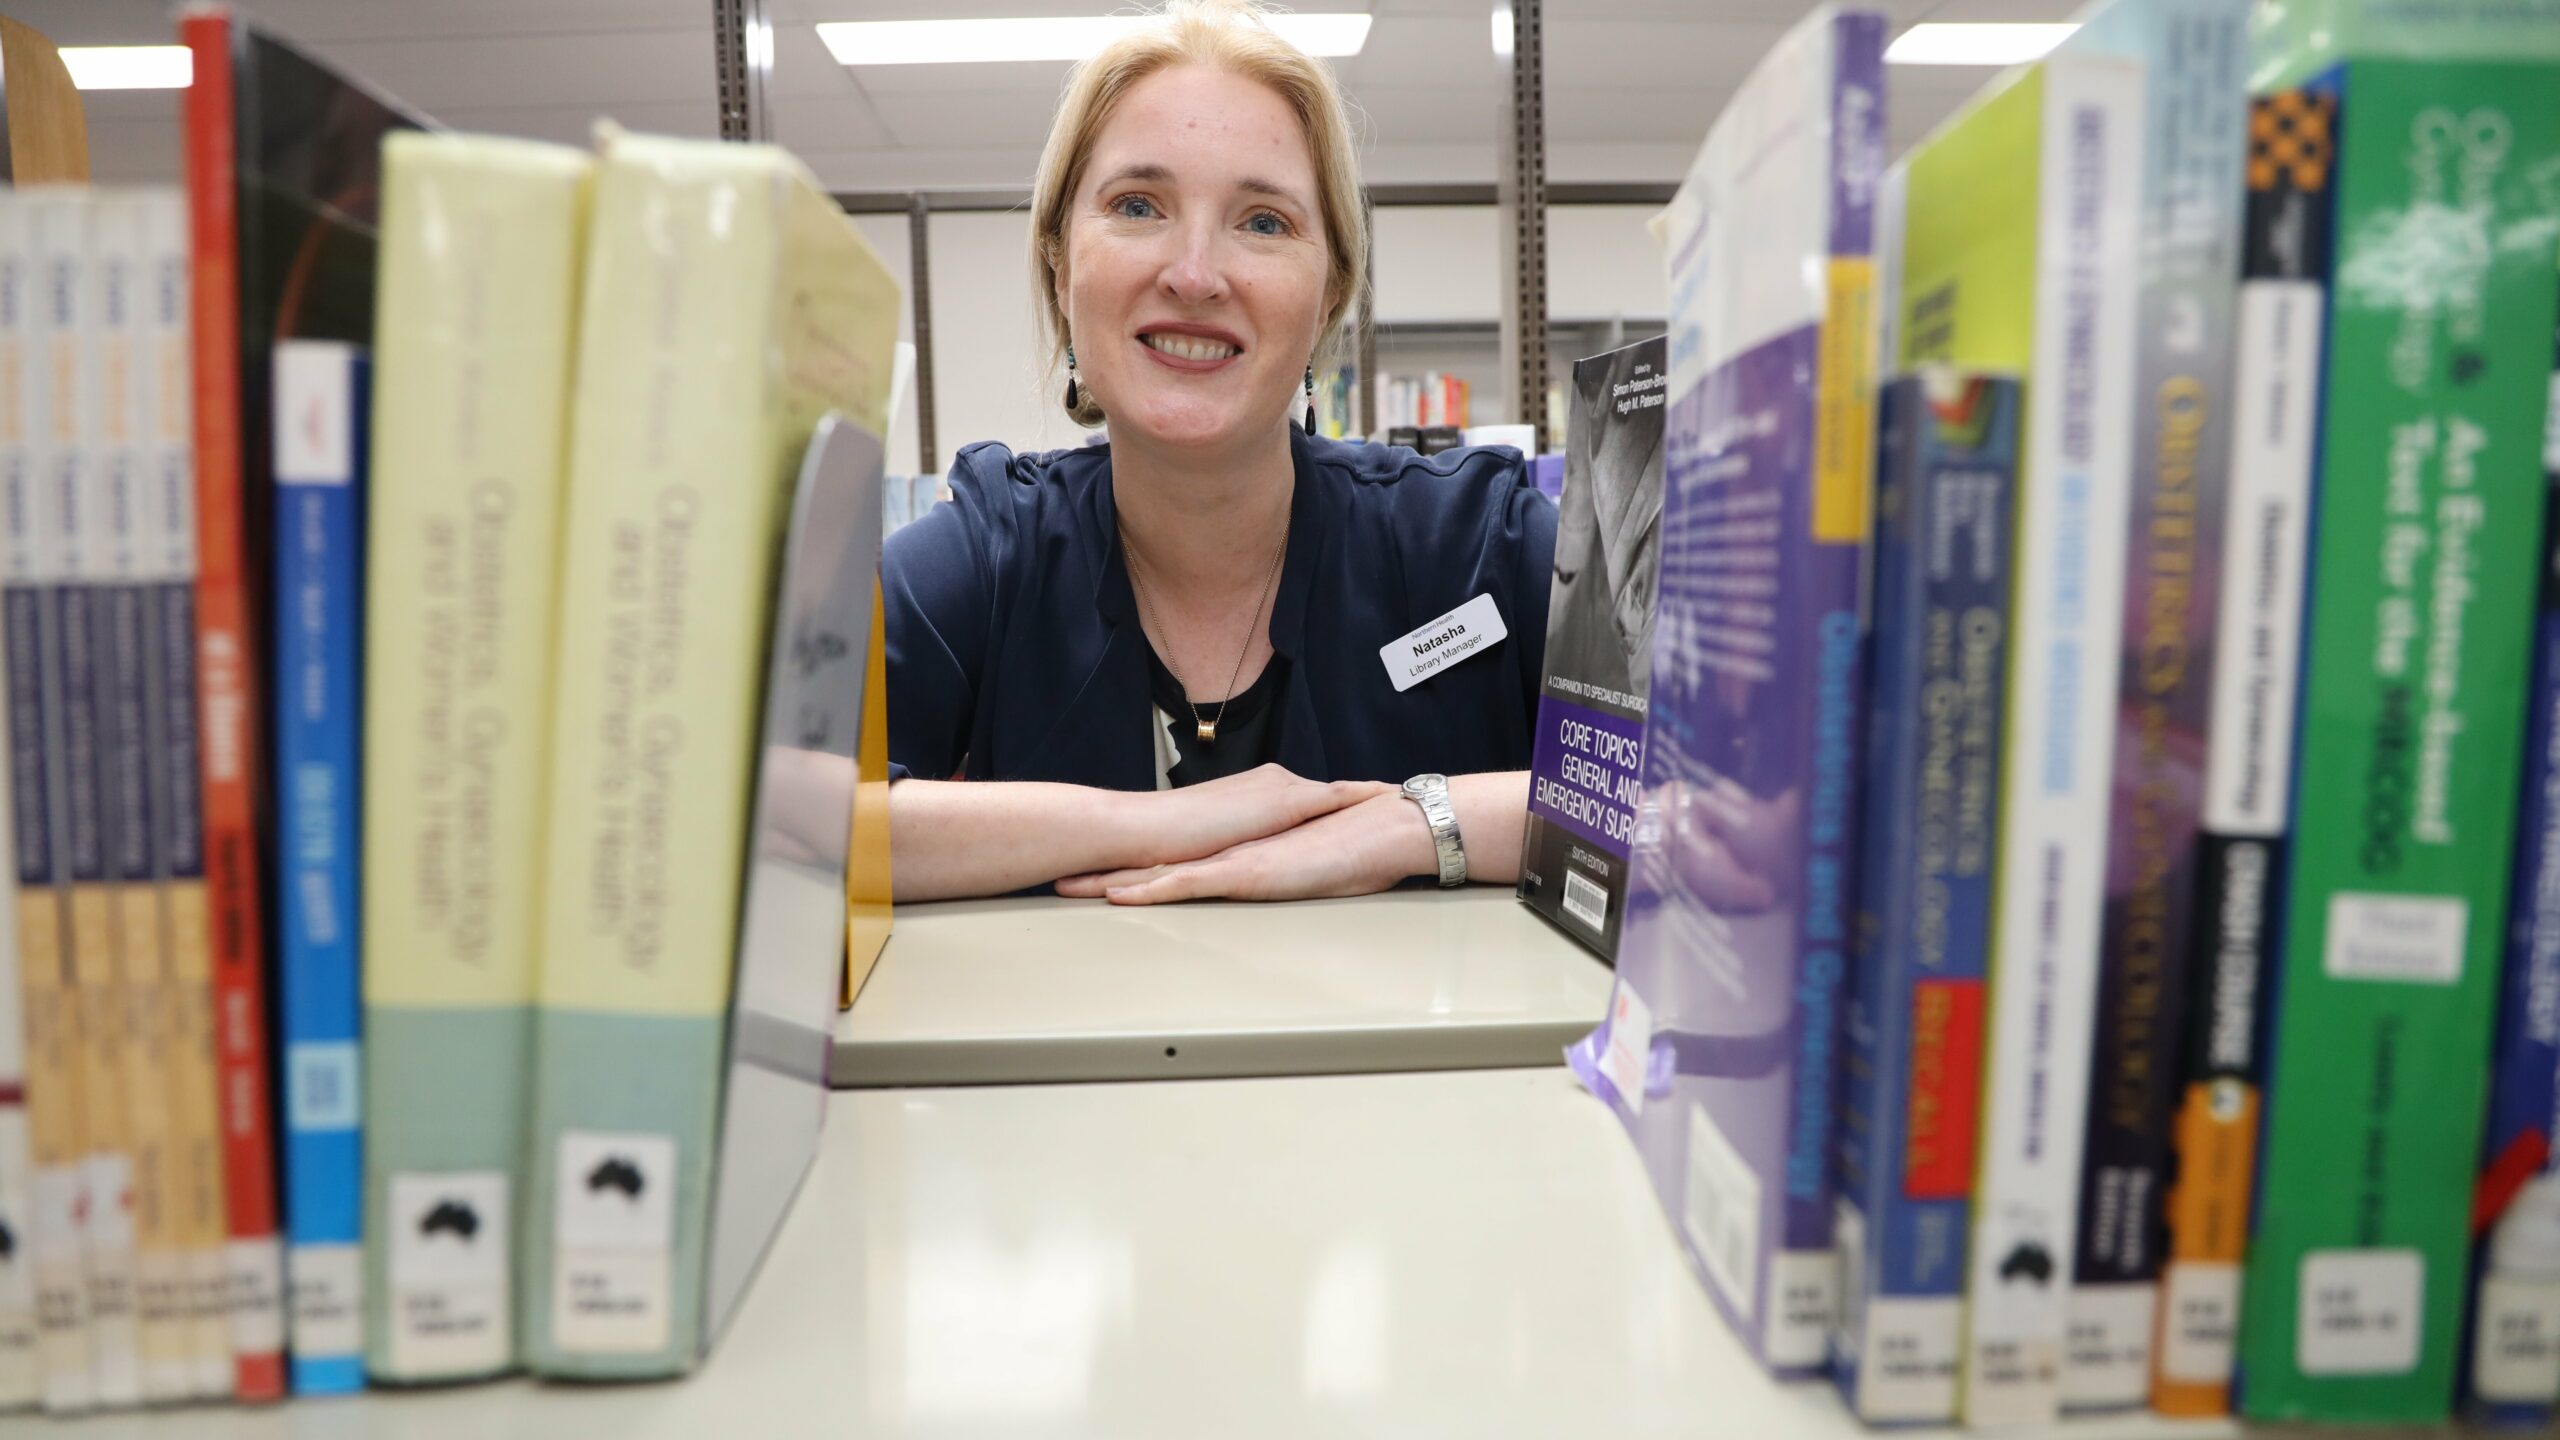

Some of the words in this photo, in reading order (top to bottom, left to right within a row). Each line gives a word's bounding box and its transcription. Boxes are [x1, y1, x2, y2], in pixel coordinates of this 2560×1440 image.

[1613, 384, 1629, 397] Simon
[1630, 373, 1668, 393] Paterson-Brow
[1617, 398, 1631, 415] Hugh
[1640, 393, 1664, 409] Paterson
[2443, 415, 2489, 488] An
[2381, 522, 2428, 588] for
[1412, 624, 1466, 657] Natasha
[1436, 614, 1454, 627] Health
[2374, 595, 2417, 675] the
[1409, 656, 1441, 677] Library
[1442, 633, 1482, 660] Manager
[2412, 495, 2486, 843] Evidence-based
[1548, 675, 1553, 687] A
[1553, 677, 1582, 695] COMPANION
[1583, 683, 1591, 697] TO
[1591, 685, 1621, 706] SPECIALIST
[1621, 694, 1648, 713] SURGICA
[1560, 718, 1593, 753] CORE
[1594, 729, 1638, 770] TOPICS
[1640, 744, 1646, 773] I
[1561, 753, 1613, 798] GENERAL
[1614, 774, 1642, 809] AND
[1536, 776, 1605, 830] EMERGENCY
[1605, 807, 1638, 847] SUR
[1572, 846, 1588, 865] SIXTH
[1587, 854, 1610, 877] EDITION
[1806, 853, 1843, 941] and
